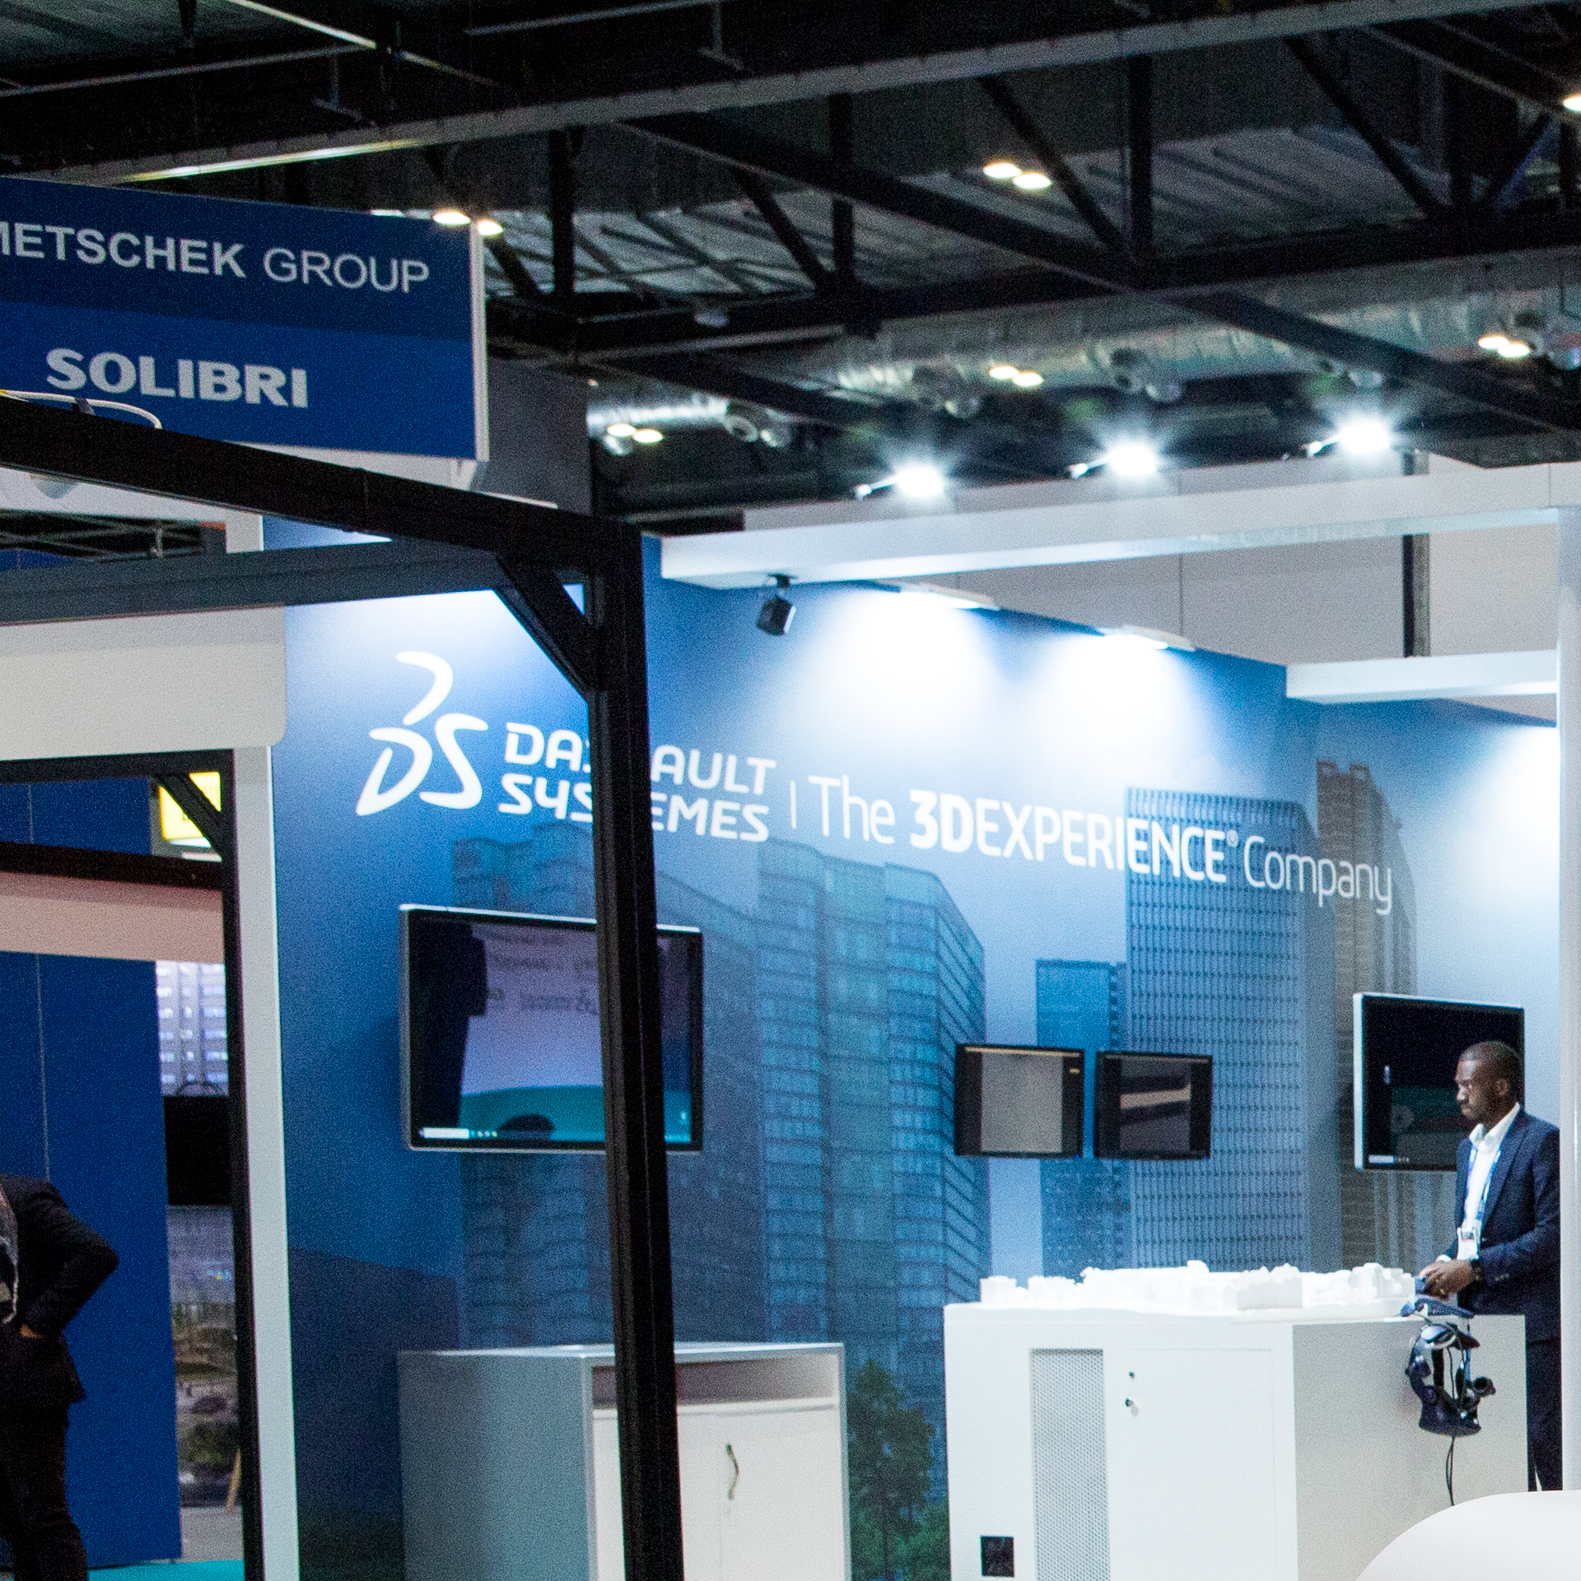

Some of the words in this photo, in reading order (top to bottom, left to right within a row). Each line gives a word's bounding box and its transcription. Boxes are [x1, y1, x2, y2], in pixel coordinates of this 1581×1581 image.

[263, 247, 430, 293] GROUP
[46, 347, 309, 409] SOLIBRI
[504, 721, 777, 796] DAAULT
[498, 772, 771, 842] SYSEMES
[808, 774, 896, 845] The
[1243, 835, 1393, 916] Company
